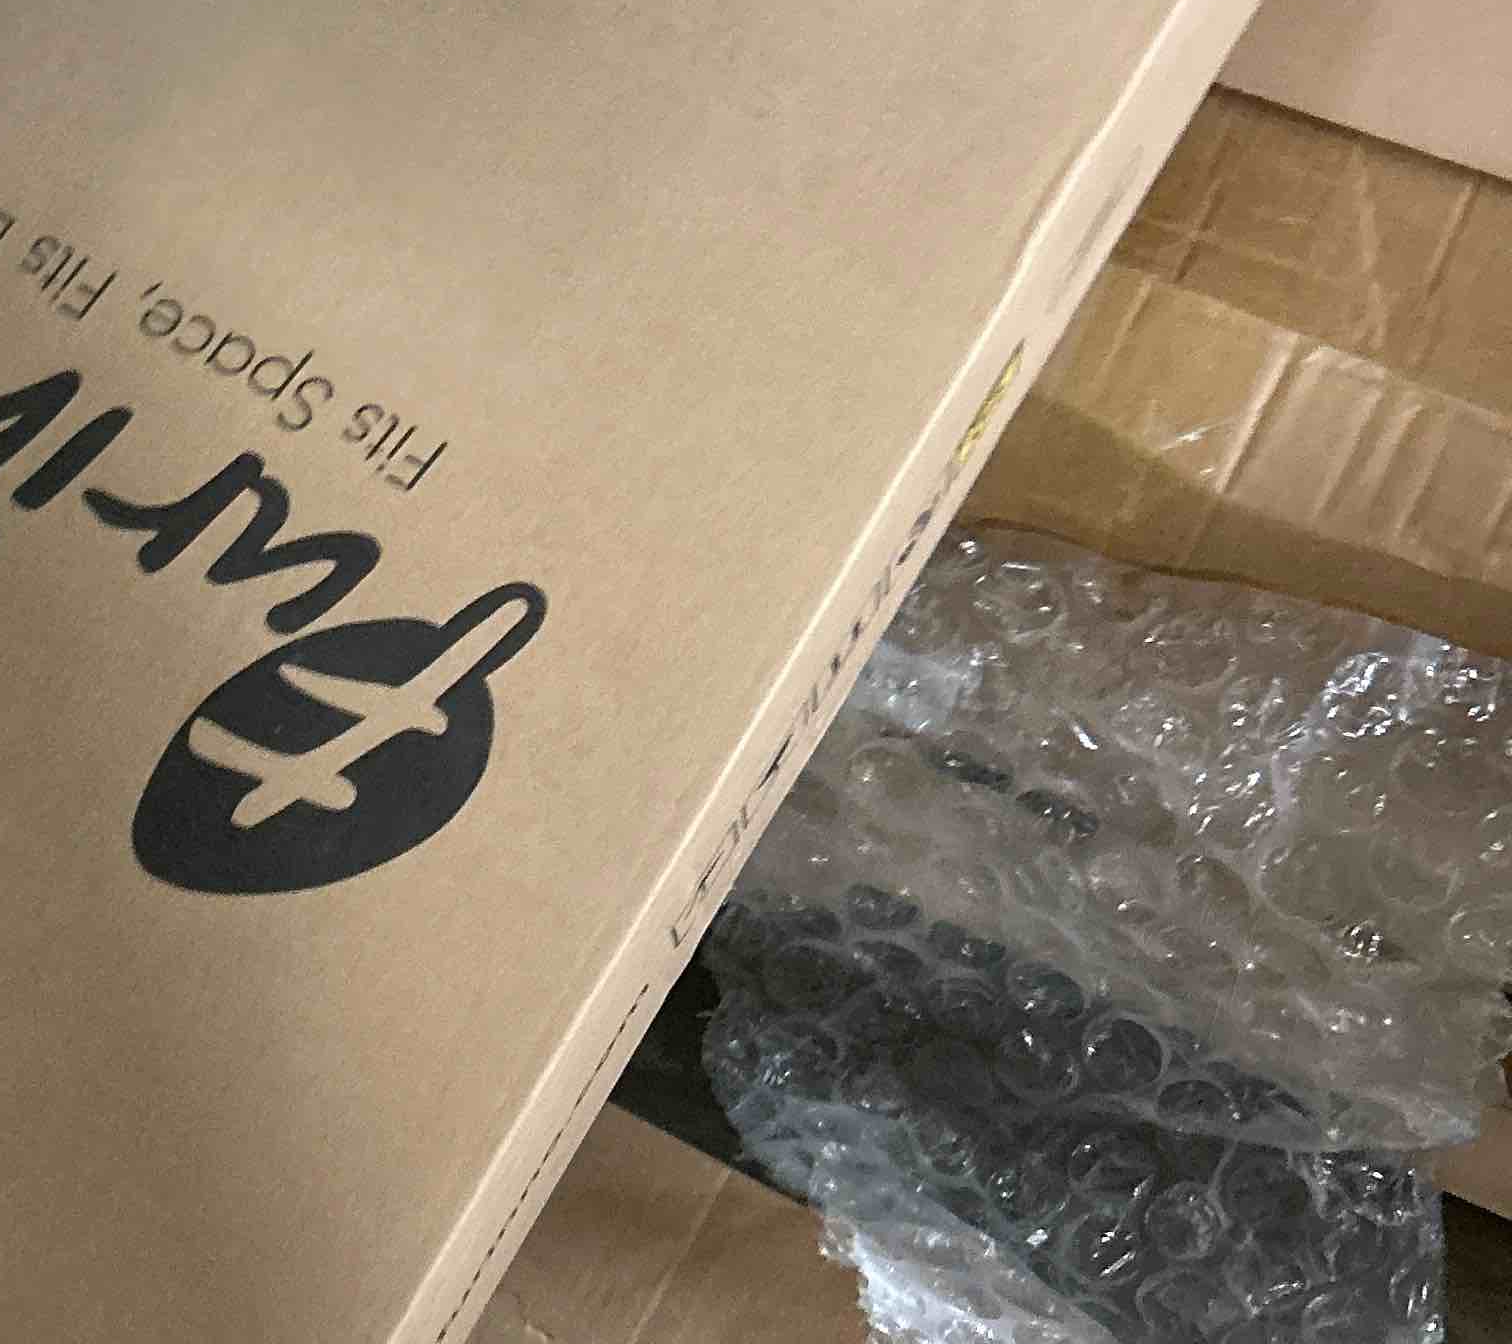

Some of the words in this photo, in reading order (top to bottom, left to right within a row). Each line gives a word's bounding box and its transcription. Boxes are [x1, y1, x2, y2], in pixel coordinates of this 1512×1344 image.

[19, 234, 119, 321] Fits
[140, 280, 335, 432] Space,
[341, 403, 448, 492] Fits
